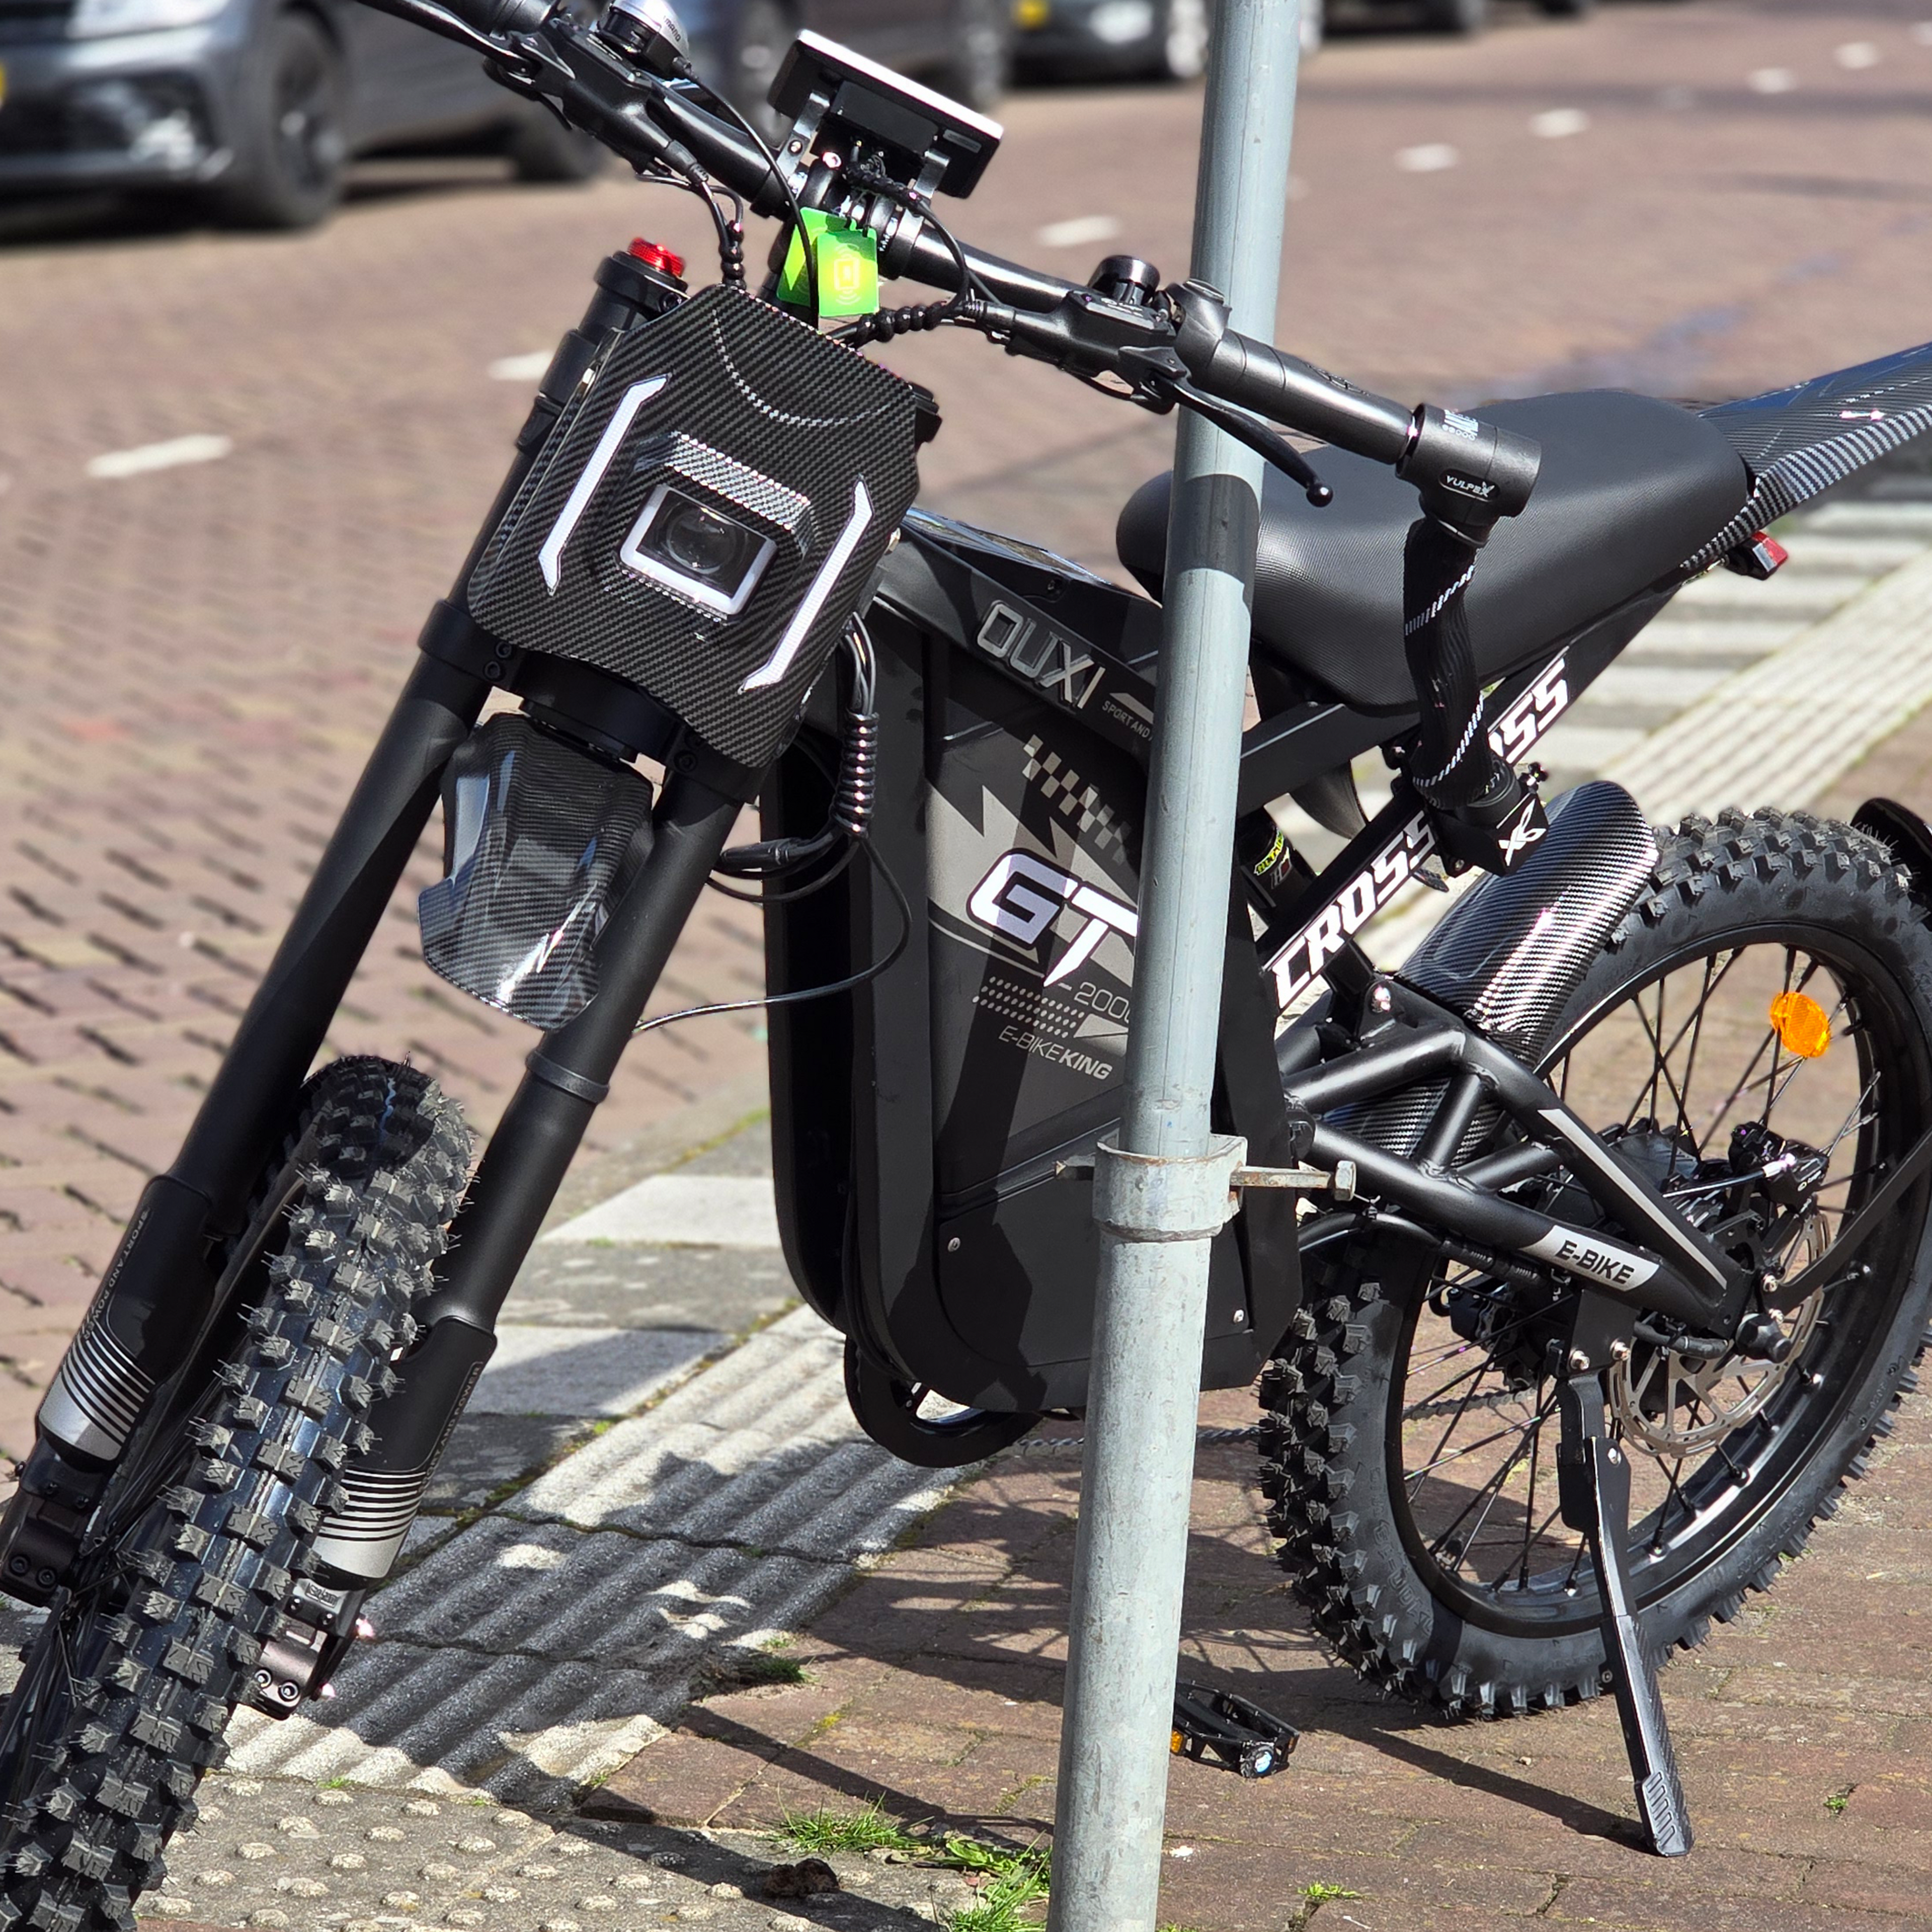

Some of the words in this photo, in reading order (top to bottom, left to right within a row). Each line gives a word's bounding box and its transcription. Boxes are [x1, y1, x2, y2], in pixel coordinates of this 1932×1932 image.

[1446, 475, 1495, 498] VULPEX
[977, 603, 1106, 709] OUXI
[1102, 700, 1134, 727] SPORT
[1130, 721, 1151, 738] AND
[969, 852, 1138, 988] GT
[1272, 810, 1435, 1008] CROSS
[1074, 982, 1130, 1024] 200
[123, 1210, 149, 1257] SPORT
[108, 1258, 124, 1288] AND
[1555, 1240, 1635, 1284] E-BIKE
[84, 1289, 111, 1340] POWER
[440, 1419, 455, 1446] AND
[454, 1366, 481, 1416] POWER
